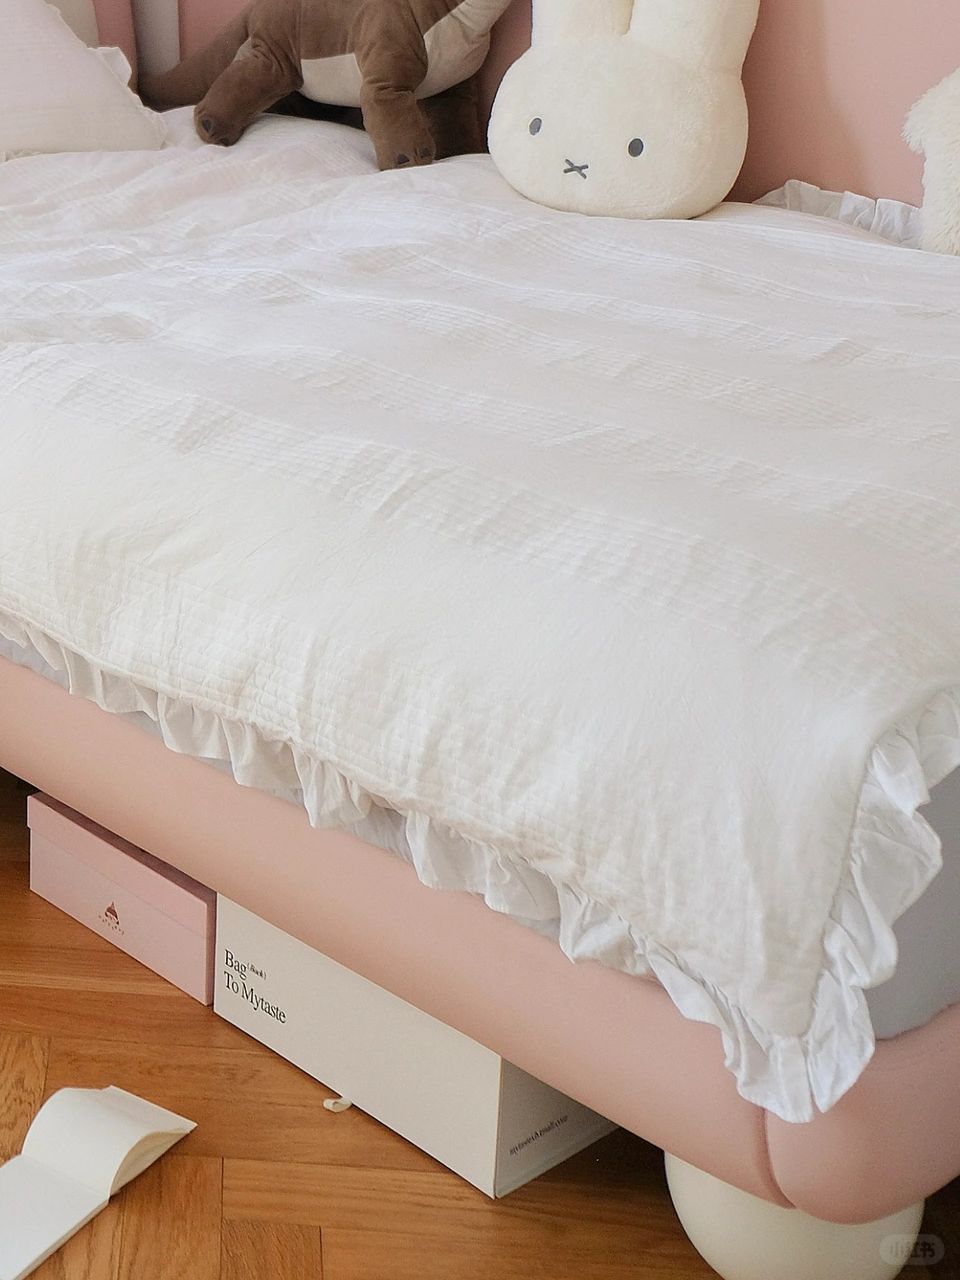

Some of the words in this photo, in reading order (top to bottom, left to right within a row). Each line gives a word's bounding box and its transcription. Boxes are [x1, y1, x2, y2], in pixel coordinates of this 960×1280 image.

[224, 949, 247, 980] Bag
[224, 971, 240, 994] To
[241, 982, 287, 1023] Mytaste
